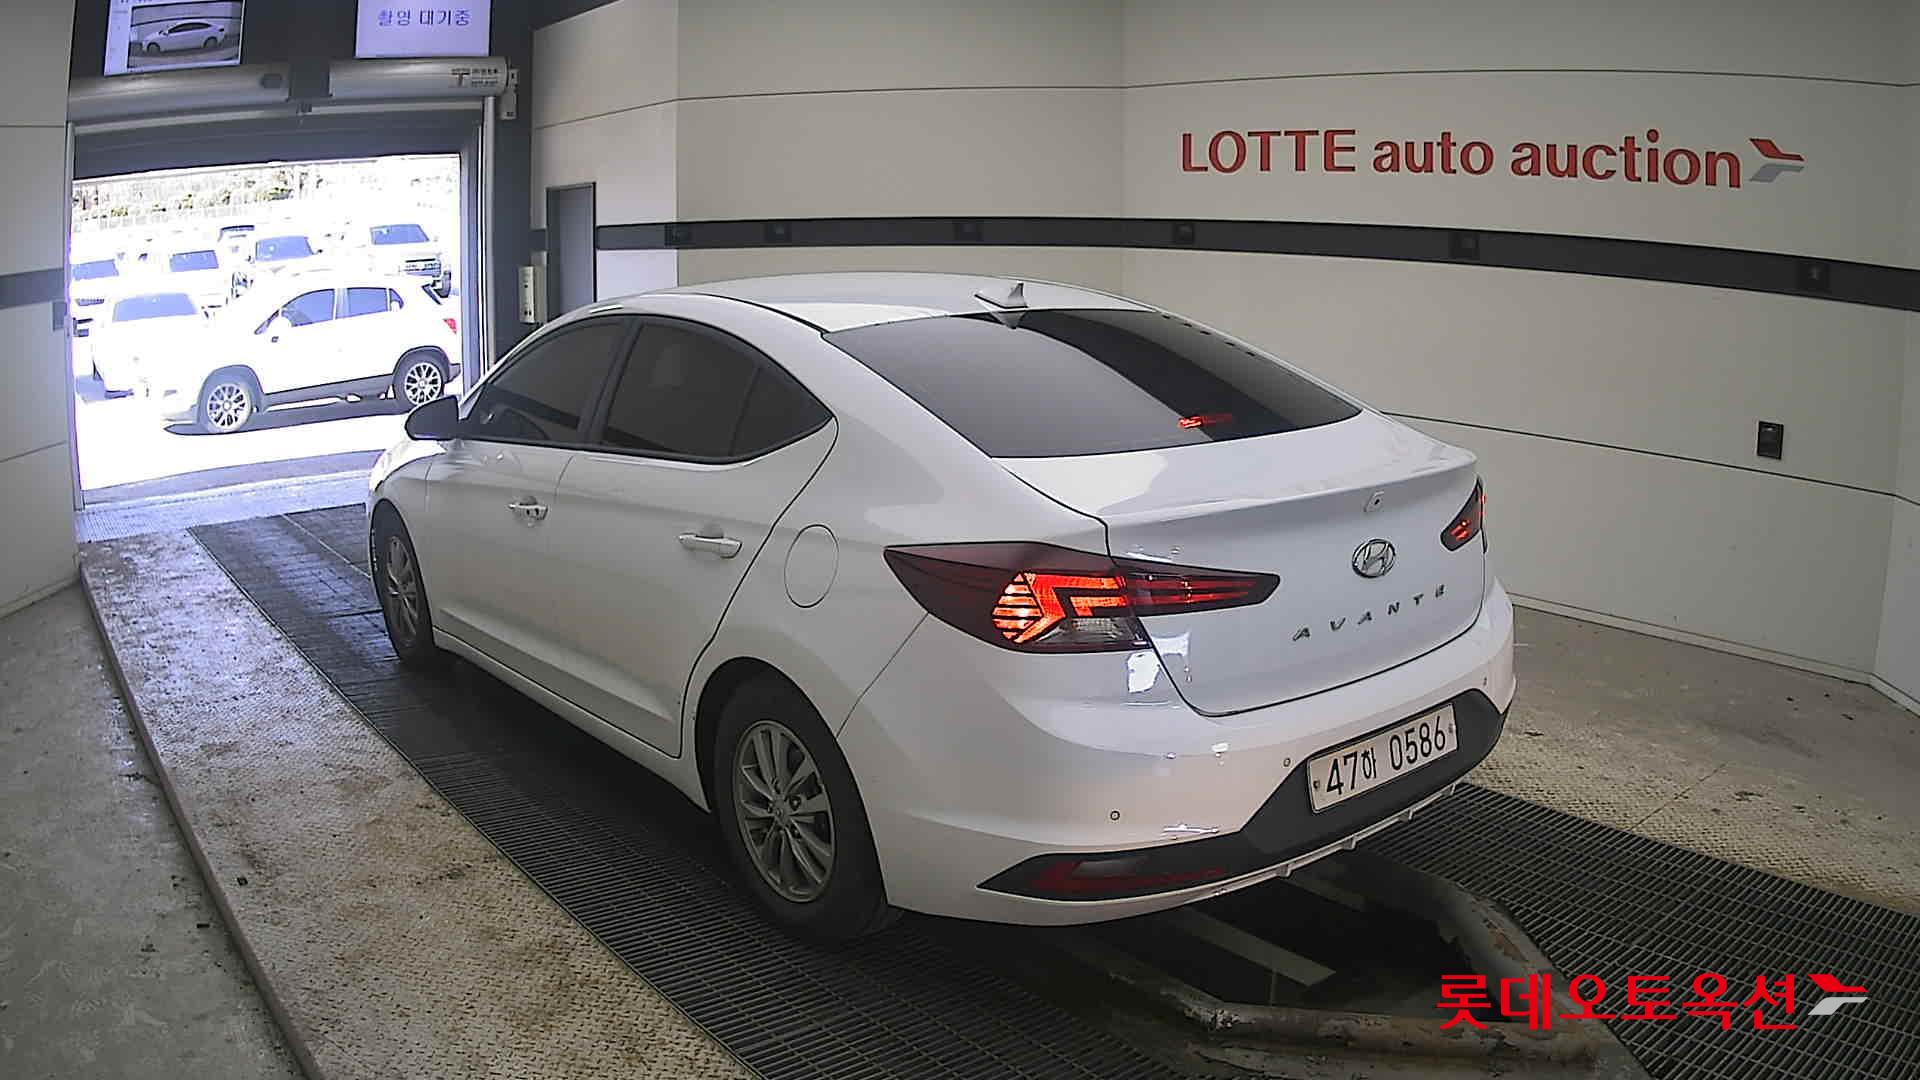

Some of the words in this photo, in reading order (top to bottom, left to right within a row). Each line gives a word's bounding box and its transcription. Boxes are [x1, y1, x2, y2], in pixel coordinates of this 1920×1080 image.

[419, 9, 471, 26] 대기중
[1181, 130, 1356, 172] LOTTE
[1373, 131, 1494, 175] auto
[1510, 128, 1741, 188] auction
[1292, 584, 1445, 641] AVANTE
[1326, 746, 1377, 795] 47하
[1389, 715, 1446, 771] 0586
